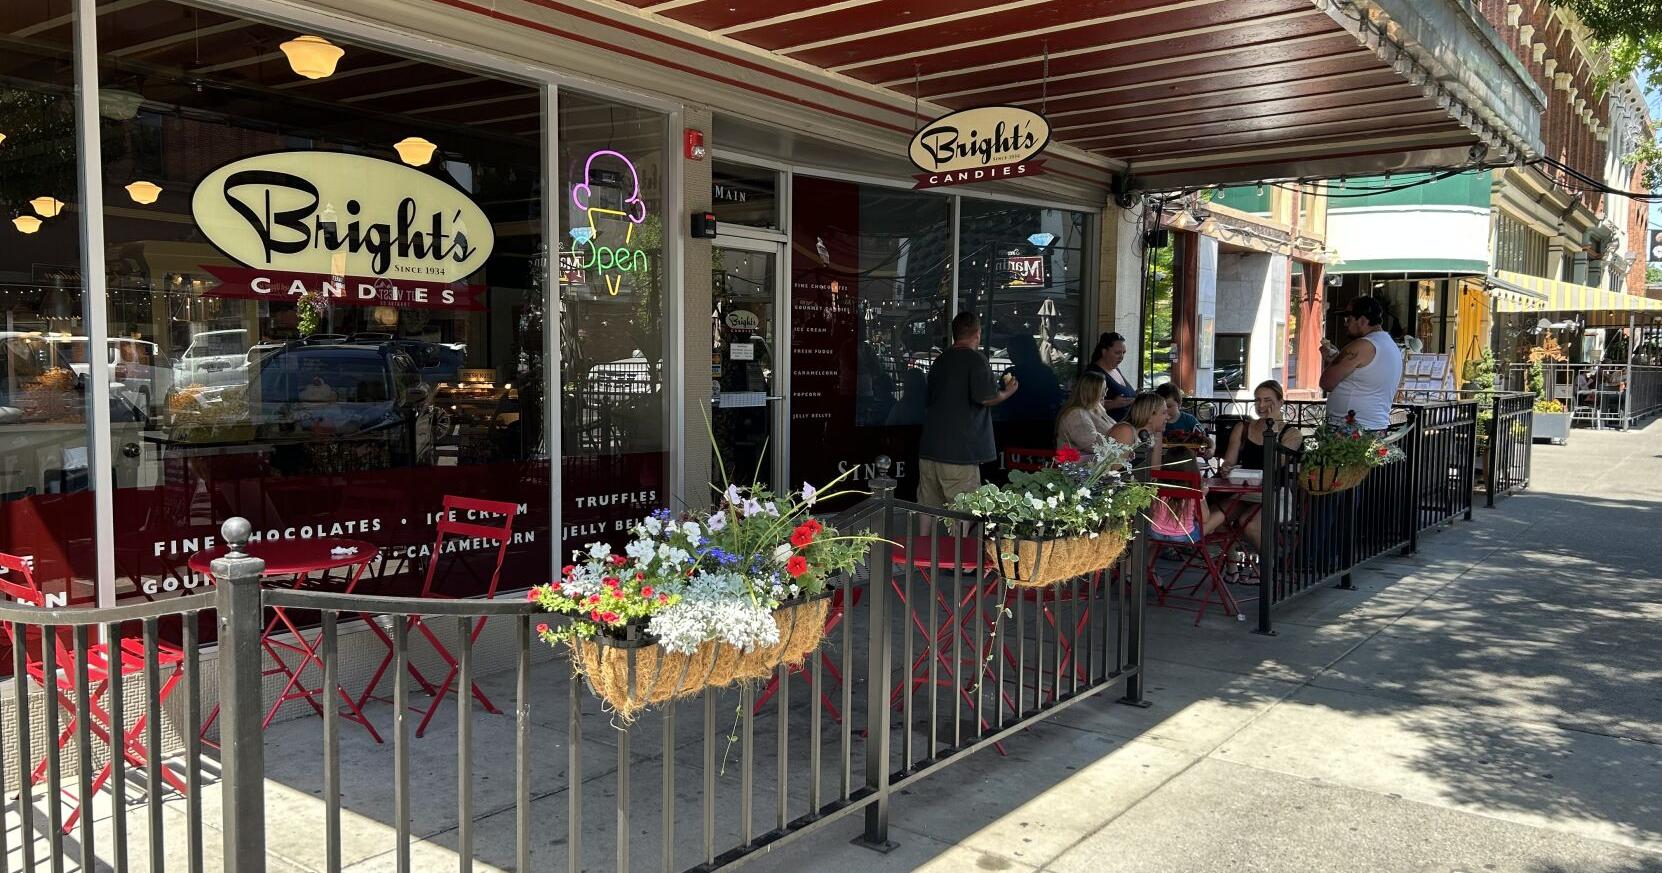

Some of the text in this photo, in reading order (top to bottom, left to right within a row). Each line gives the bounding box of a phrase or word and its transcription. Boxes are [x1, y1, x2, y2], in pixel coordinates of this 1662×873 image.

[920, 120, 1039, 169] Bright's
[929, 164, 1026, 184] CANDIES
[223, 169, 477, 276] Bright's
[571, 236, 648, 275] Open
[425, 266, 446, 276] 1934
[250, 277, 455, 304] CANDIES
[837, 460, 905, 482] SINE
[575, 490, 656, 508] TRUFFLES
[154, 536, 215, 556] FINE
[247, 518, 381, 542] HOCOLATES
[562, 521, 606, 541] JELLY
